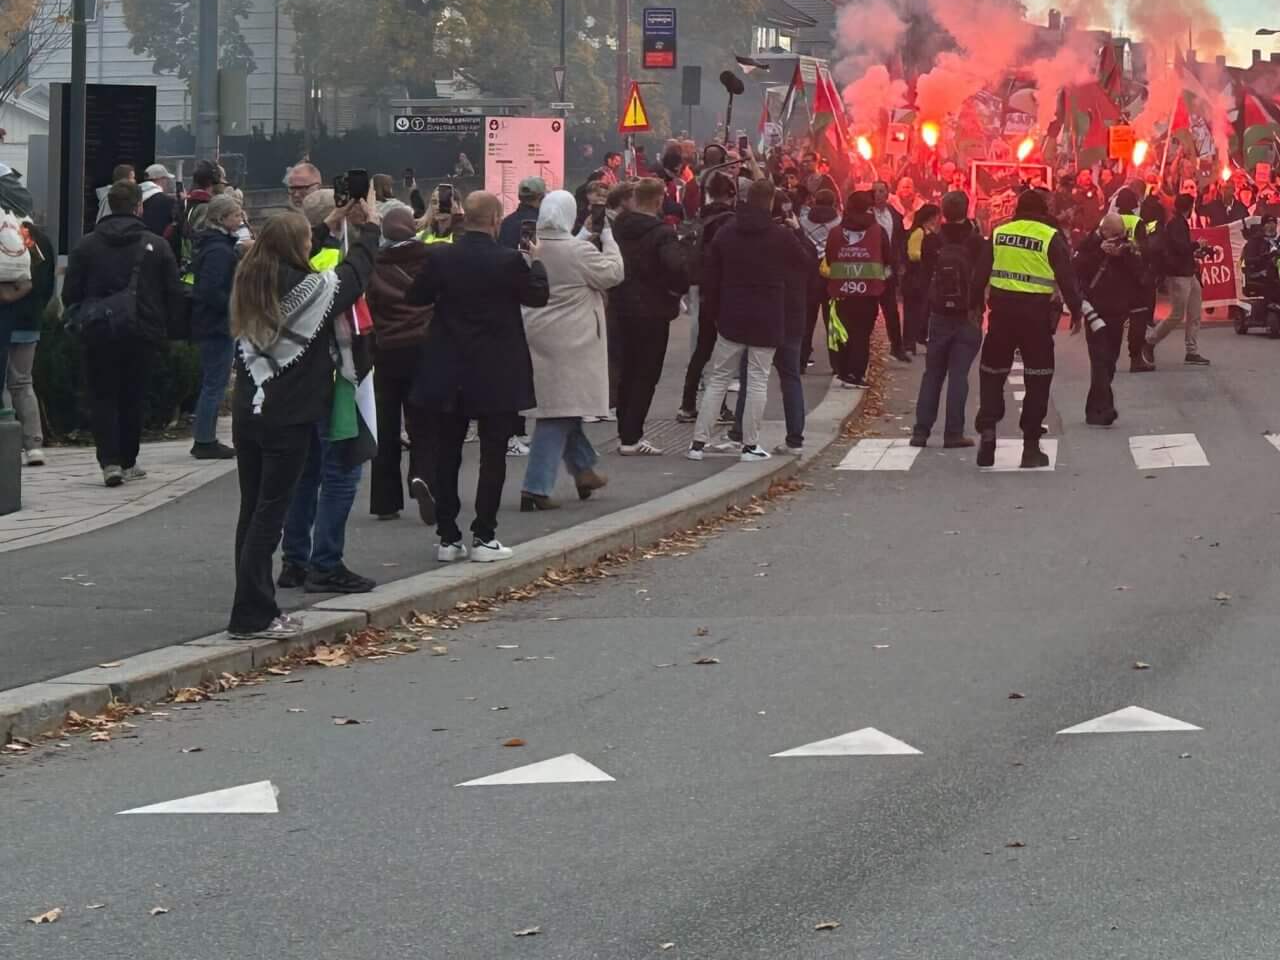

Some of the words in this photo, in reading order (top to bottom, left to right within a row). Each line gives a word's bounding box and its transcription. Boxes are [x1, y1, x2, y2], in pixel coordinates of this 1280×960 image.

[997, 234, 1042, 251] POLITI
[843, 263, 865, 277] TV
[1201, 265, 1231, 285] ARD
[839, 281, 867, 294] 490
